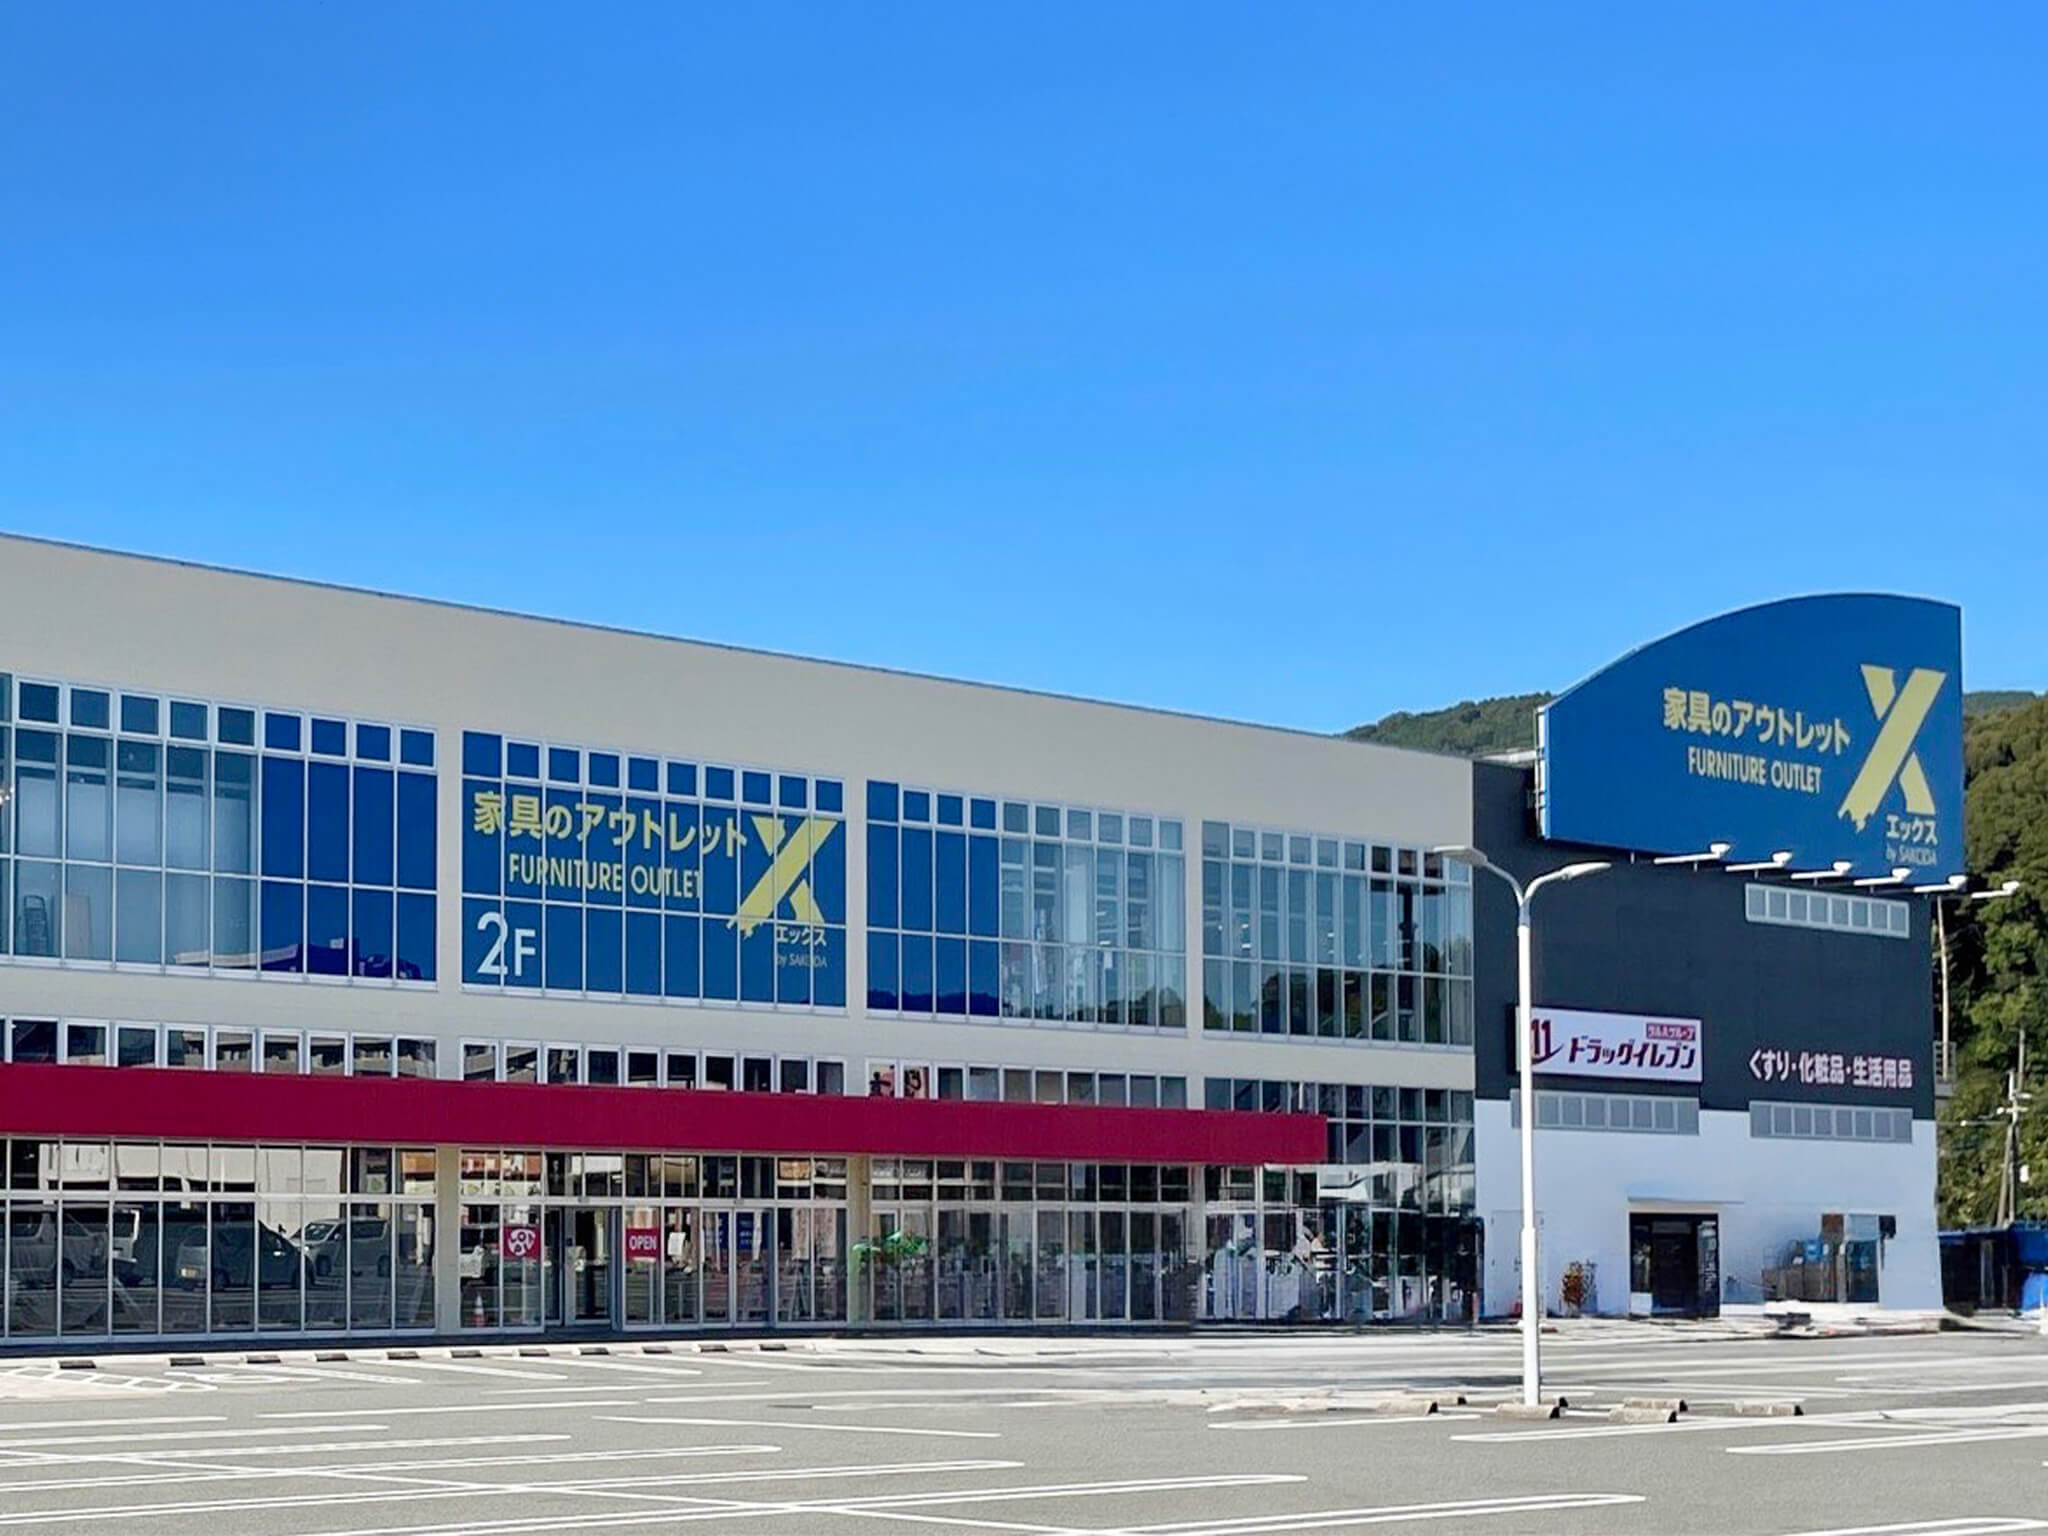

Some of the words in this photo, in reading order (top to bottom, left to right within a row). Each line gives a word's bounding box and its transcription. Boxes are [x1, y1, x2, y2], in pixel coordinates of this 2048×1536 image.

[1663, 687, 1850, 755] 家具のアウトレット
[1688, 747, 1766, 786] FURNITURE
[1771, 760, 1822, 794] OUTLET
[473, 790, 748, 858] 家具のアウトレット
[1886, 814, 1938, 846] エックス
[509, 853, 622, 892] FURNITURE
[630, 865, 702, 900] OUTLET
[477, 912, 536, 977] 2F
[776, 926, 827, 947] エックス
[1569, 1036, 1696, 1070] ドラッグイレブン
[1749, 1049, 1913, 1088] くすり・化粧品・生活用品
[629, 1235, 657, 1250] OPEN
